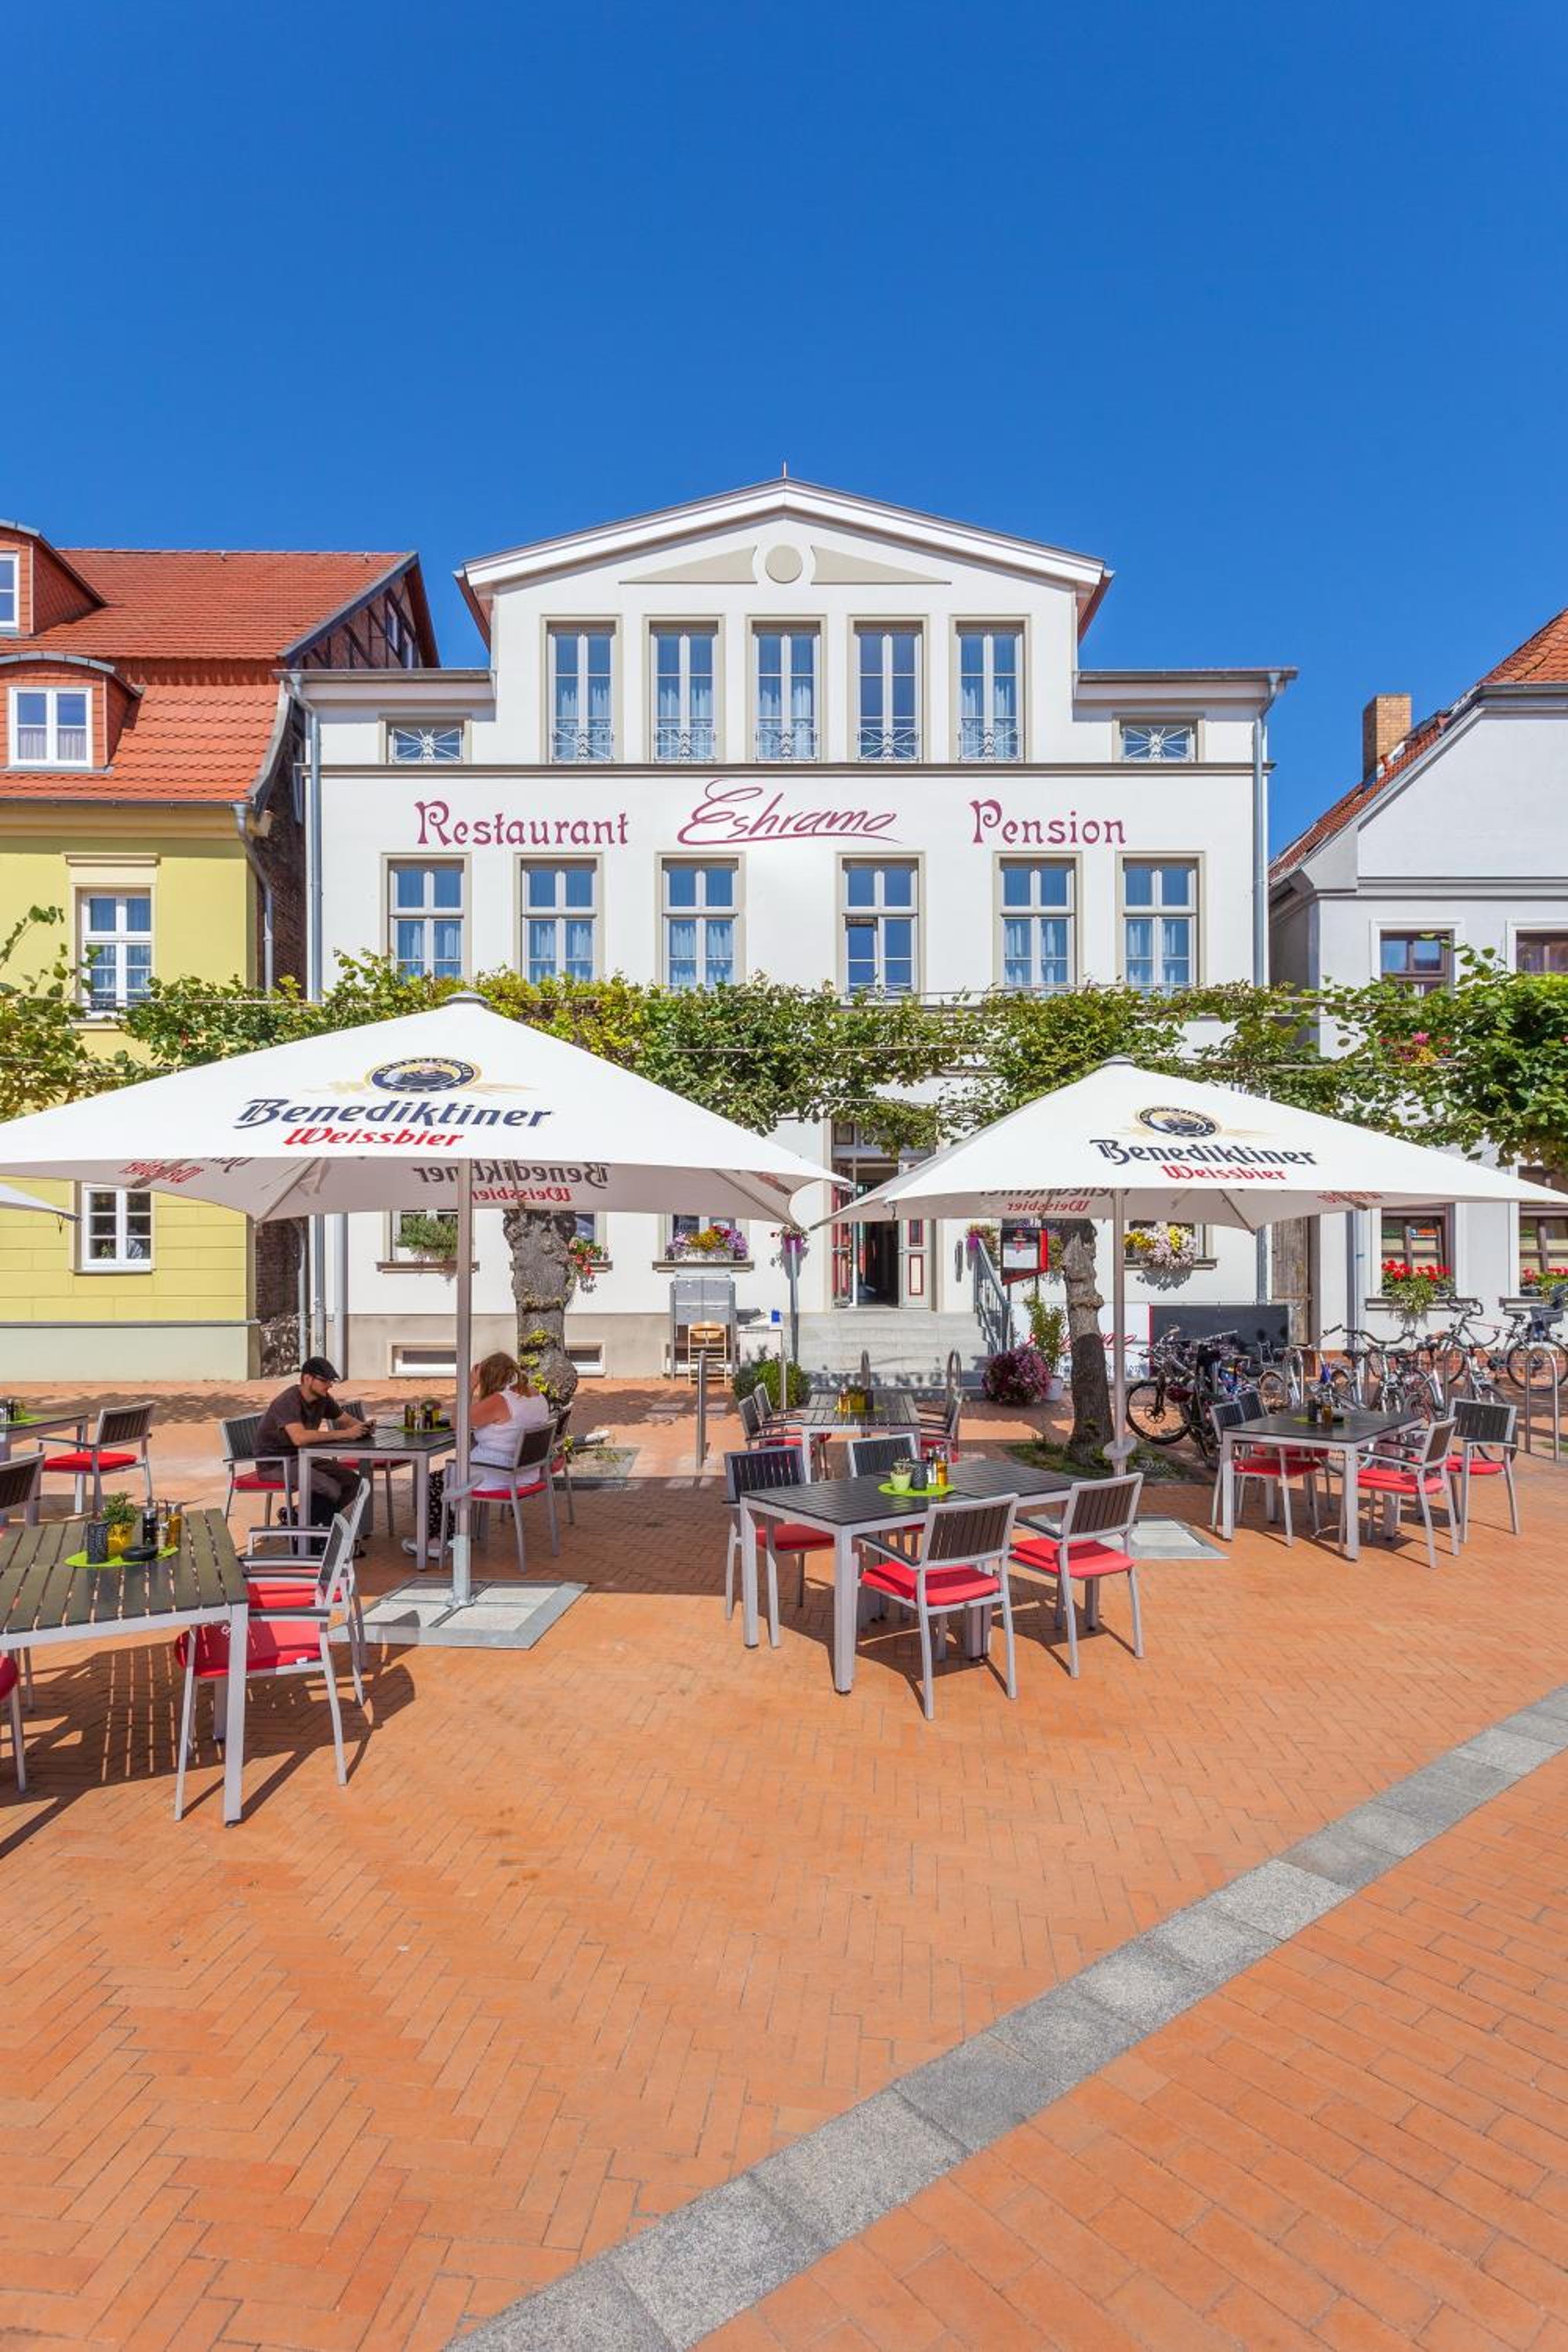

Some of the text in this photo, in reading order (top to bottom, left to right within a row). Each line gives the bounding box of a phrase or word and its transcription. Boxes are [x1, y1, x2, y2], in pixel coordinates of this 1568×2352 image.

[414, 779, 1127, 846] Restaurant Eshramo Pension
[233, 1098, 554, 1130] Benediktiner
[283, 1127, 465, 1147] Weissbier
[1088, 1138, 1319, 1167] Benediktiner
[1160, 1164, 1288, 1181] Weissbier
